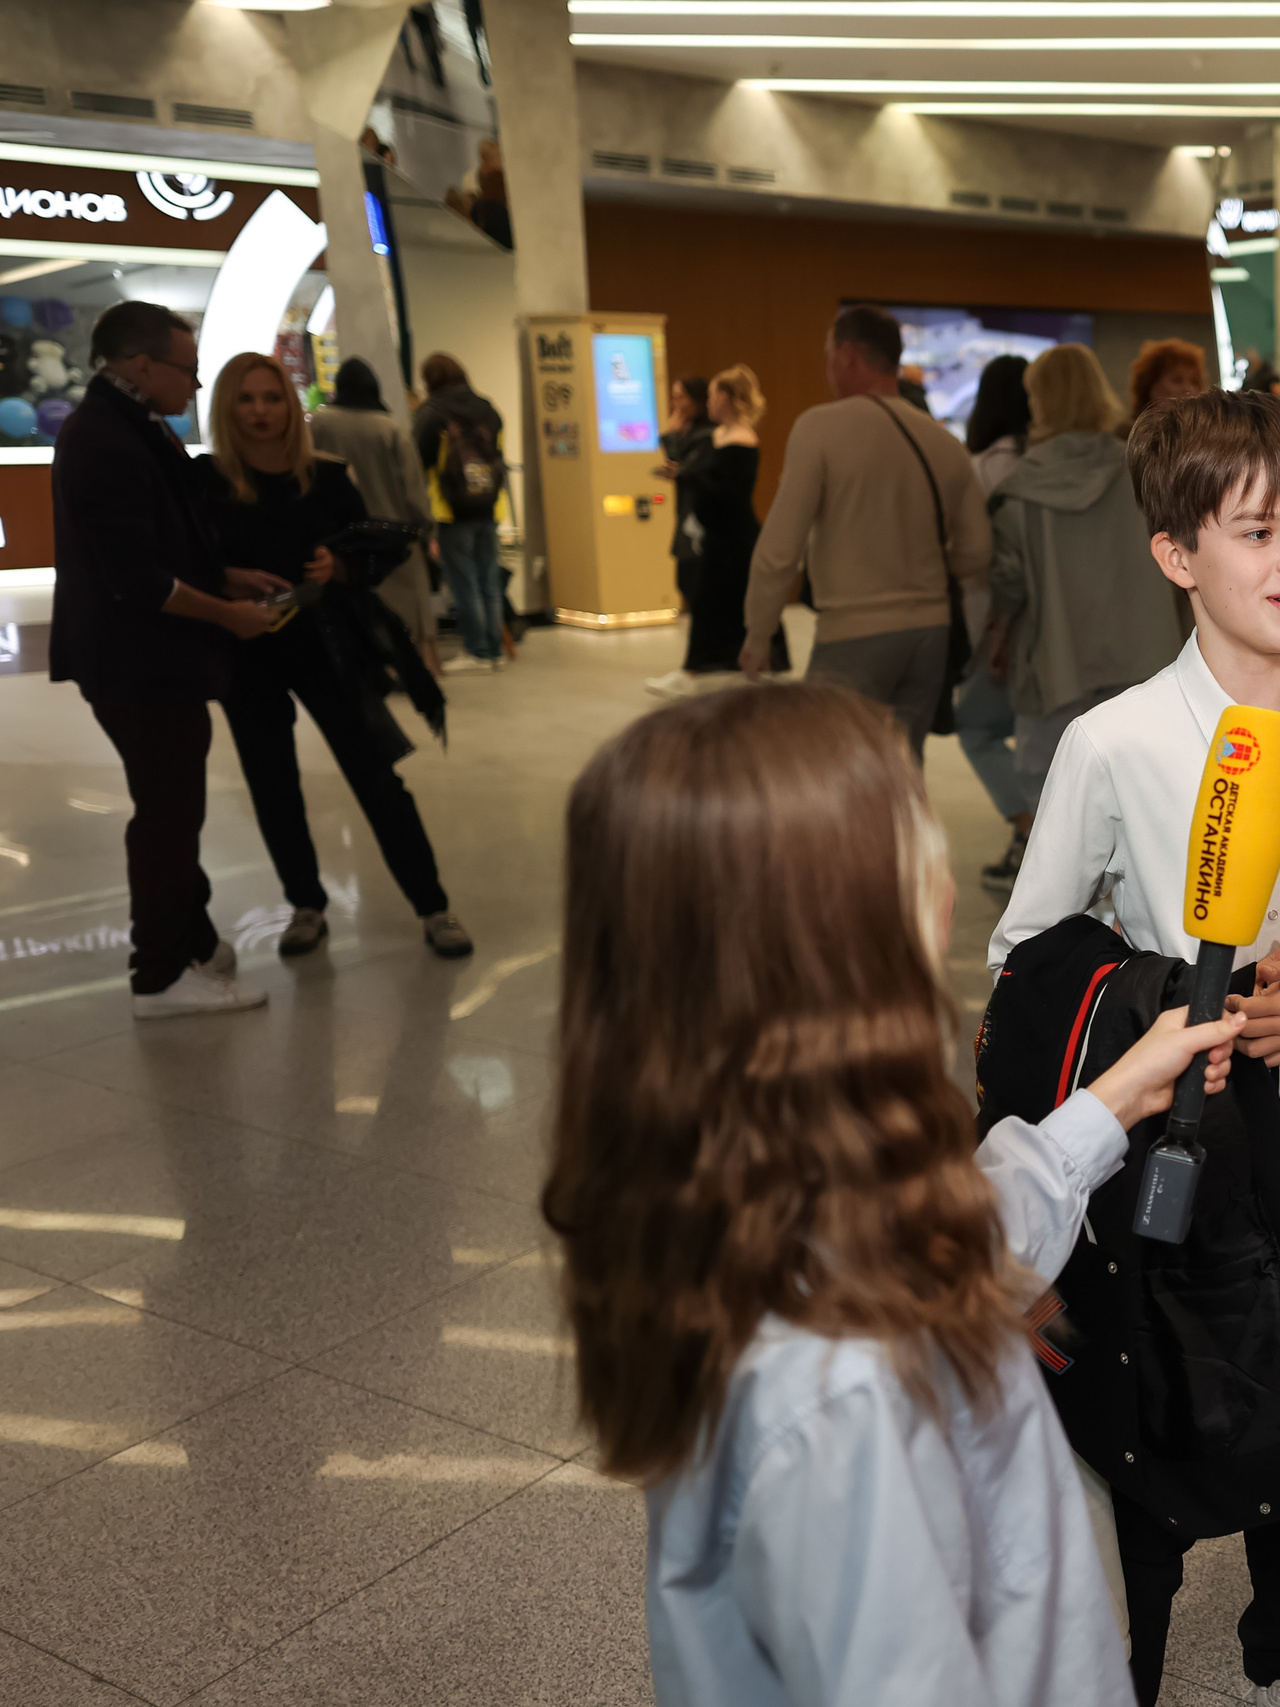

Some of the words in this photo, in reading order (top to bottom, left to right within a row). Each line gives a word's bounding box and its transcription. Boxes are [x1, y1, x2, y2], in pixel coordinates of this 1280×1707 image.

[1222, 781, 1240, 834] ДЕТСКАЯ
[1193, 777, 1229, 921] ОСТАНКИНО
[1213, 835, 1230, 898] АКАДЕМИЯ
